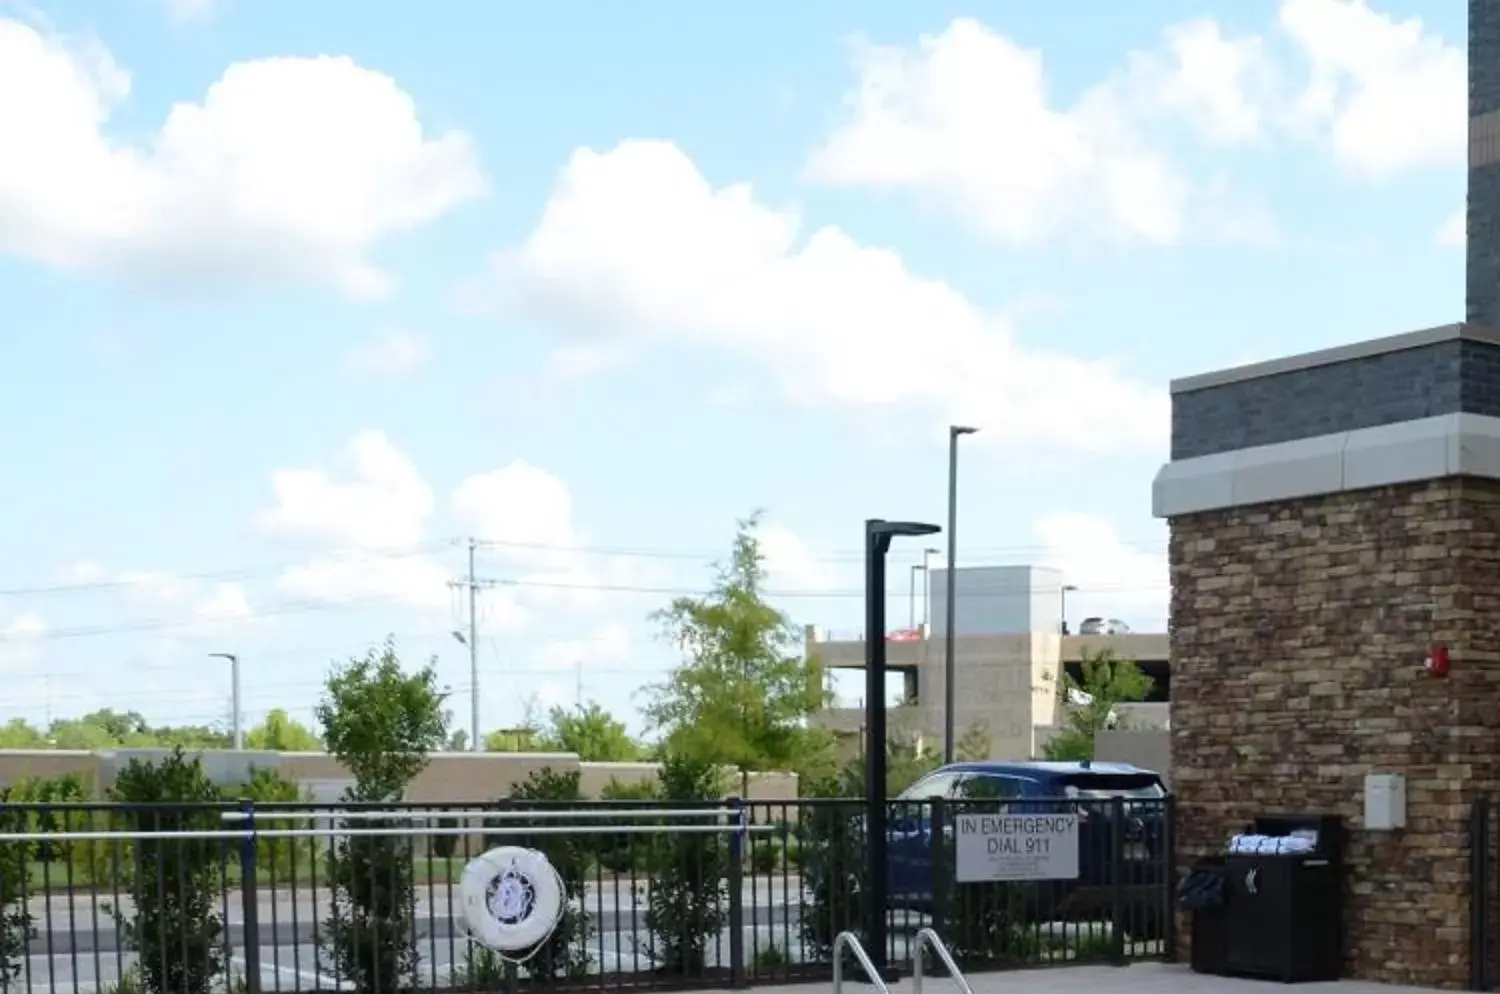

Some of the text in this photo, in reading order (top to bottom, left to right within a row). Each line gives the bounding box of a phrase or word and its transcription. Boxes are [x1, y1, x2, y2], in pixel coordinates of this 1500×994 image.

[961, 817, 1074, 835] IN EMERGENCY
[987, 837, 1051, 854] DIAL 911
